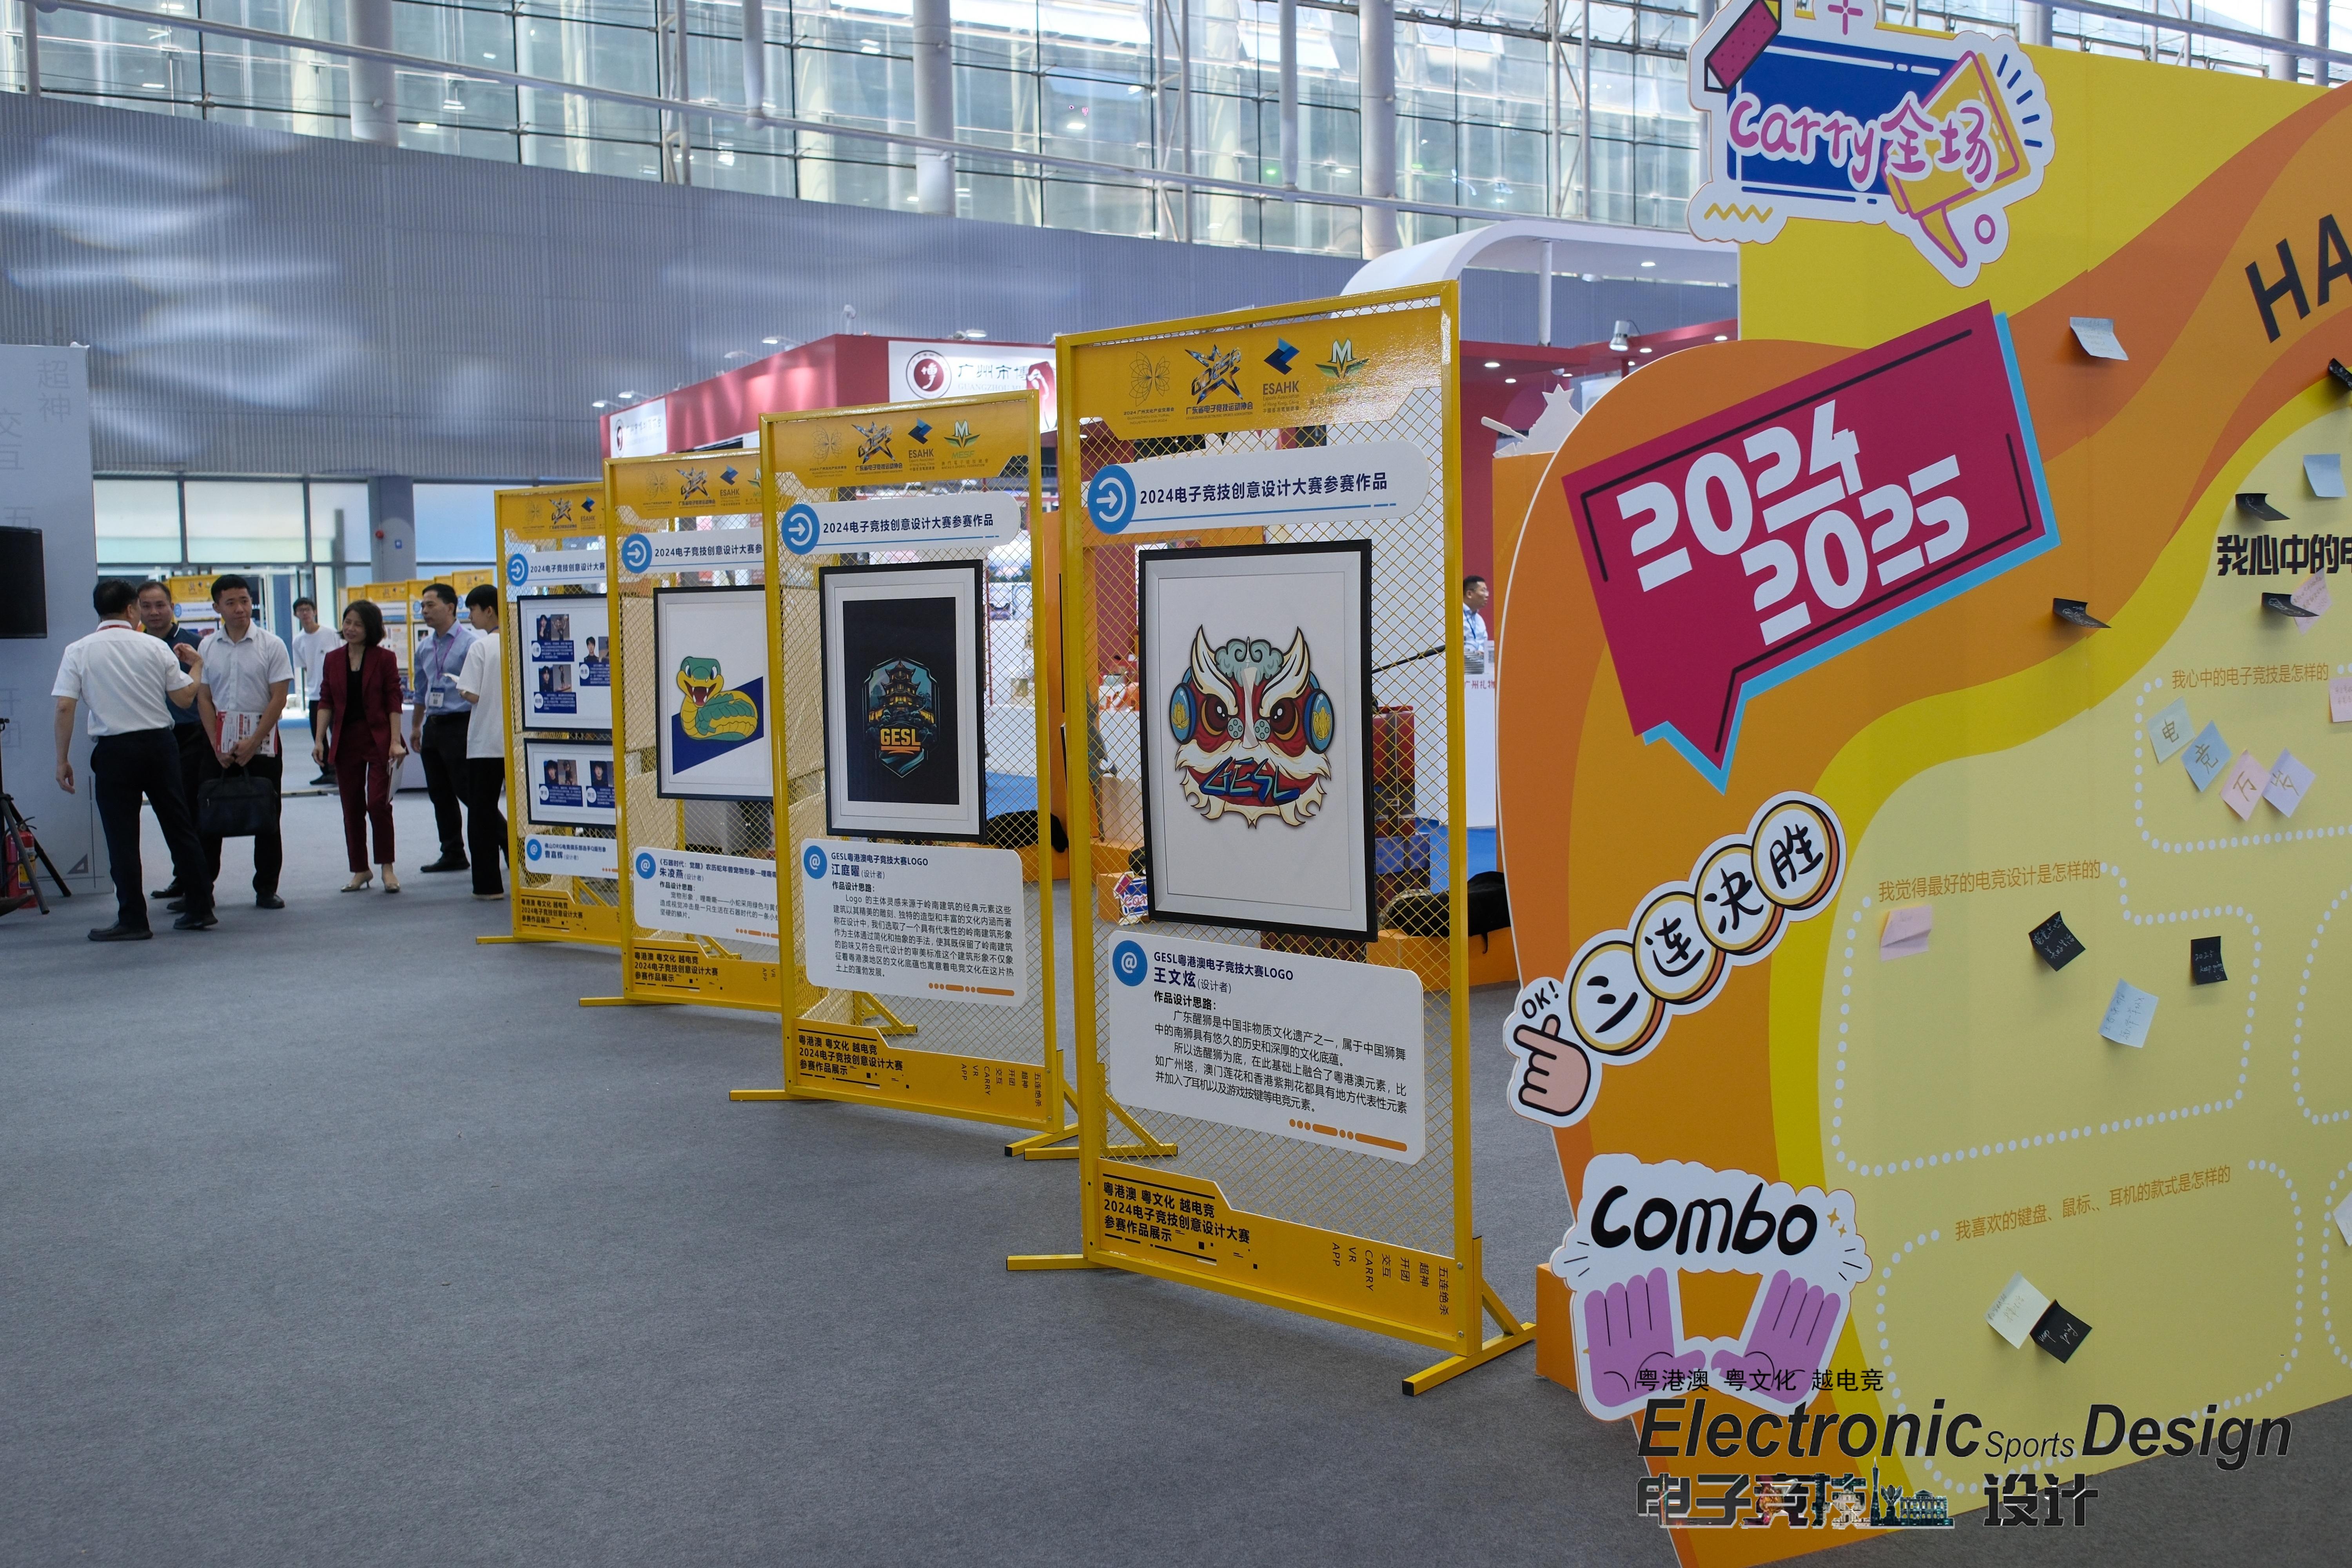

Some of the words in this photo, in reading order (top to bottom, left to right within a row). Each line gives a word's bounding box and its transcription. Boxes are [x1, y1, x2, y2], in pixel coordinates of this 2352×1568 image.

[38, 359, 71, 423] 超神
[1263, 381, 1299, 395] ESAHK
[1186, 401, 1253, 415] 广东省电子竞技运动协会
[909, 448, 934, 458] ESAHK
[951, 451, 975, 459] MESF
[1140, 472, 1387, 505] 2024电子竞技创意设计大赛参赛作品
[1616, 399, 1864, 592] 2024
[824, 513, 993, 533] 2024电子竞技创意设计大赛参赛作品
[655, 544, 762, 557] 2024电子竞技创意设计大赛参
[1740, 455, 1969, 646] 2025
[531, 562, 605, 573] 2024电子竞技创意设计大赛
[2172, 662, 2329, 690] 我心中的电子竞技是怎样的
[880, 728, 921, 746] GESL
[2162, 719, 2179, 743] 电
[2233, 771, 2257, 802] 万
[831, 853, 928, 866] GESL粤港澳电子竞技大赛LOGO
[1878, 859, 2100, 902] 我觉得最好的电竞设计是怎样的
[846, 894, 862, 904] Logo
[865, 895, 1011, 915] 的主体灵感来源于岭南建筑的经典元素这些
[635, 962, 718, 976] 2024电子竞技创意设计大赛
[657, 953, 676, 963] 粤文化
[679, 955, 699, 964] 越电竞
[1154, 951, 1294, 980] GESL粤港澳电子竞技大赛LOGO
[635, 971, 674, 982] 参赛作品展示
[1521, 980, 1560, 1019] OK!
[799, 1034, 822, 1048] 粤港澳
[826, 1038, 849, 1051] 粤文化
[852, 1042, 877, 1055] 越电竞
[1154, 1023, 1345, 1067] 中的南狮具有悠久的历史和深厚的文化底蕴。
[1173, 1011, 1406, 1061] 广东醒狮是中国非物质文化遗产之一，属于中国狮舞
[799, 1047, 903, 1071] 2024电子竞技创意设计大赛
[800, 1059, 848, 1075] 参赛作品展示
[973, 1065, 979, 1077] VR
[1174, 1042, 1407, 1097] 所以选醒狮为底，在此基础上融合了粤港澳元素，比
[996, 1067, 1003, 1085] 交互
[1008, 1069, 1015, 1086] 开团
[1021, 1071, 1028, 1089] 超神
[1155, 1056, 1408, 1114] 如广州塔，澳门莲花和香港紫荆花都具有地方代表性元素
[1155, 1071, 1317, 1113] 并加入了耳机以及游戏按键等电竞元素。
[1103, 1181, 1137, 1202] 粤港澳
[1141, 1187, 1175, 1210] 粤文化
[1179, 1197, 1216, 1220] 越电竞
[1103, 1198, 1250, 1245] 2024电子竞技创意设计大赛
[1104, 1215, 1172, 1244] 参赛作品展示
[1591, 1182, 1818, 1256] Combo
[1332, 1242, 1341, 1267] APP
[1348, 1247, 1356, 1263] VR
[1381, 1253, 1391, 1279] 交互
[1364, 1249, 1374, 1292] CARRY
[1399, 1257, 1410, 1283] 开团
[1419, 1261, 1430, 1288] 超神
[1438, 1265, 1450, 1316] 五连绝杀
